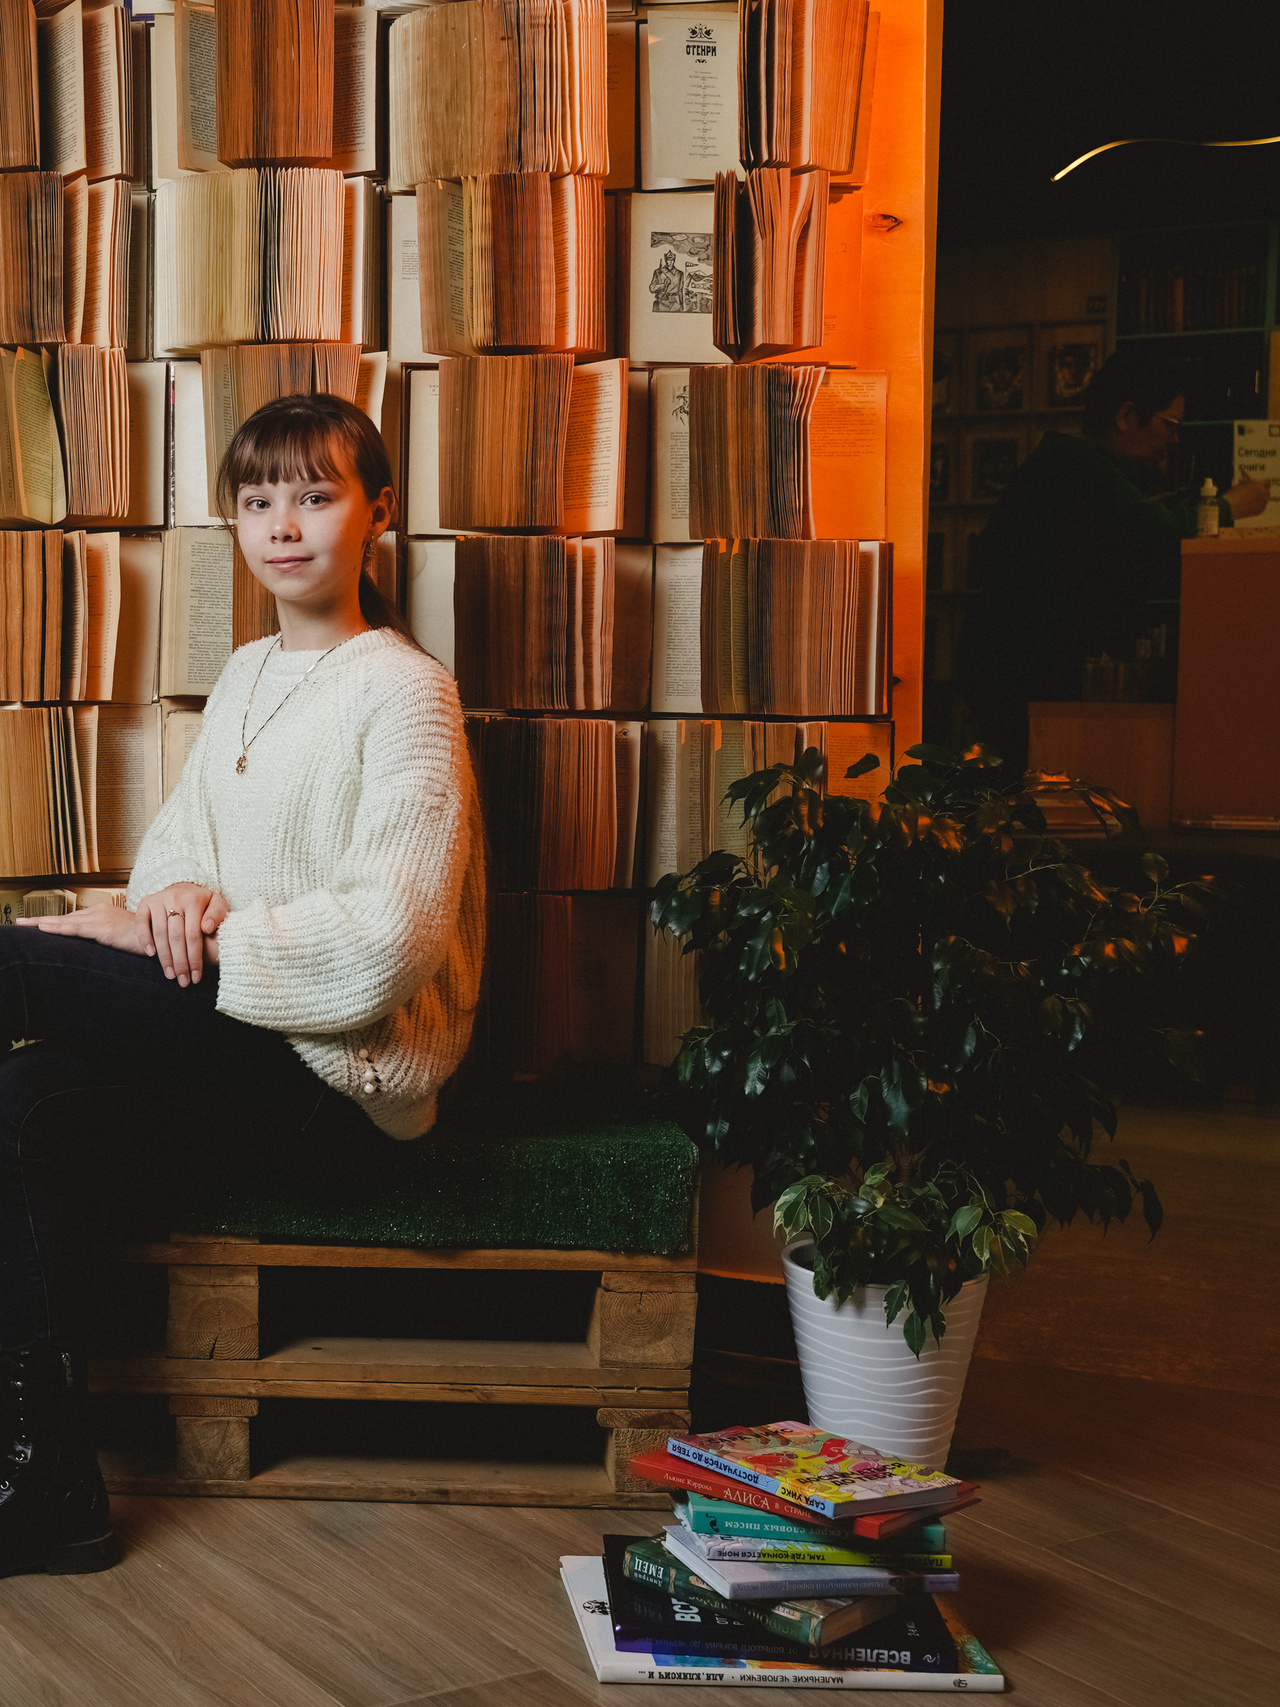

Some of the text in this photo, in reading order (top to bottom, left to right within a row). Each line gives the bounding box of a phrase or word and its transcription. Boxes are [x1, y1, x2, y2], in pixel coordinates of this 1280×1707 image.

[1237, 447, 1277, 458] Сегодня
[671, 1444, 759, 1484] ДОСТУЧАТЬСЯ ДО ТЕБЯ
[663, 1473, 713, 1491] Льюис Кэрролл
[723, 1487, 770, 1510] АЛИСА
[784, 1504, 812, 1518] СТРАНЕ
[781, 1487, 826, 1511] САРА УИКС
[724, 1520, 849, 1540] Секрет еловых писем
[741, 1551, 790, 1560] КОНЧАЕТСЯ
[634, 1555, 665, 1579] ЕМЕЦ
[633, 1571, 663, 1587] Дмитрий
[705, 1642, 738, 1650] ВЗРЫВА
[741, 1645, 785, 1654] БОЛЬШОГО
[809, 1645, 911, 1665] ВСЕЛЕННАЯ
[740, 1674, 792, 1683] ЧЕЛОВЕЧКИ
[793, 1675, 844, 1684] МАЛЕНЬКИЕ
